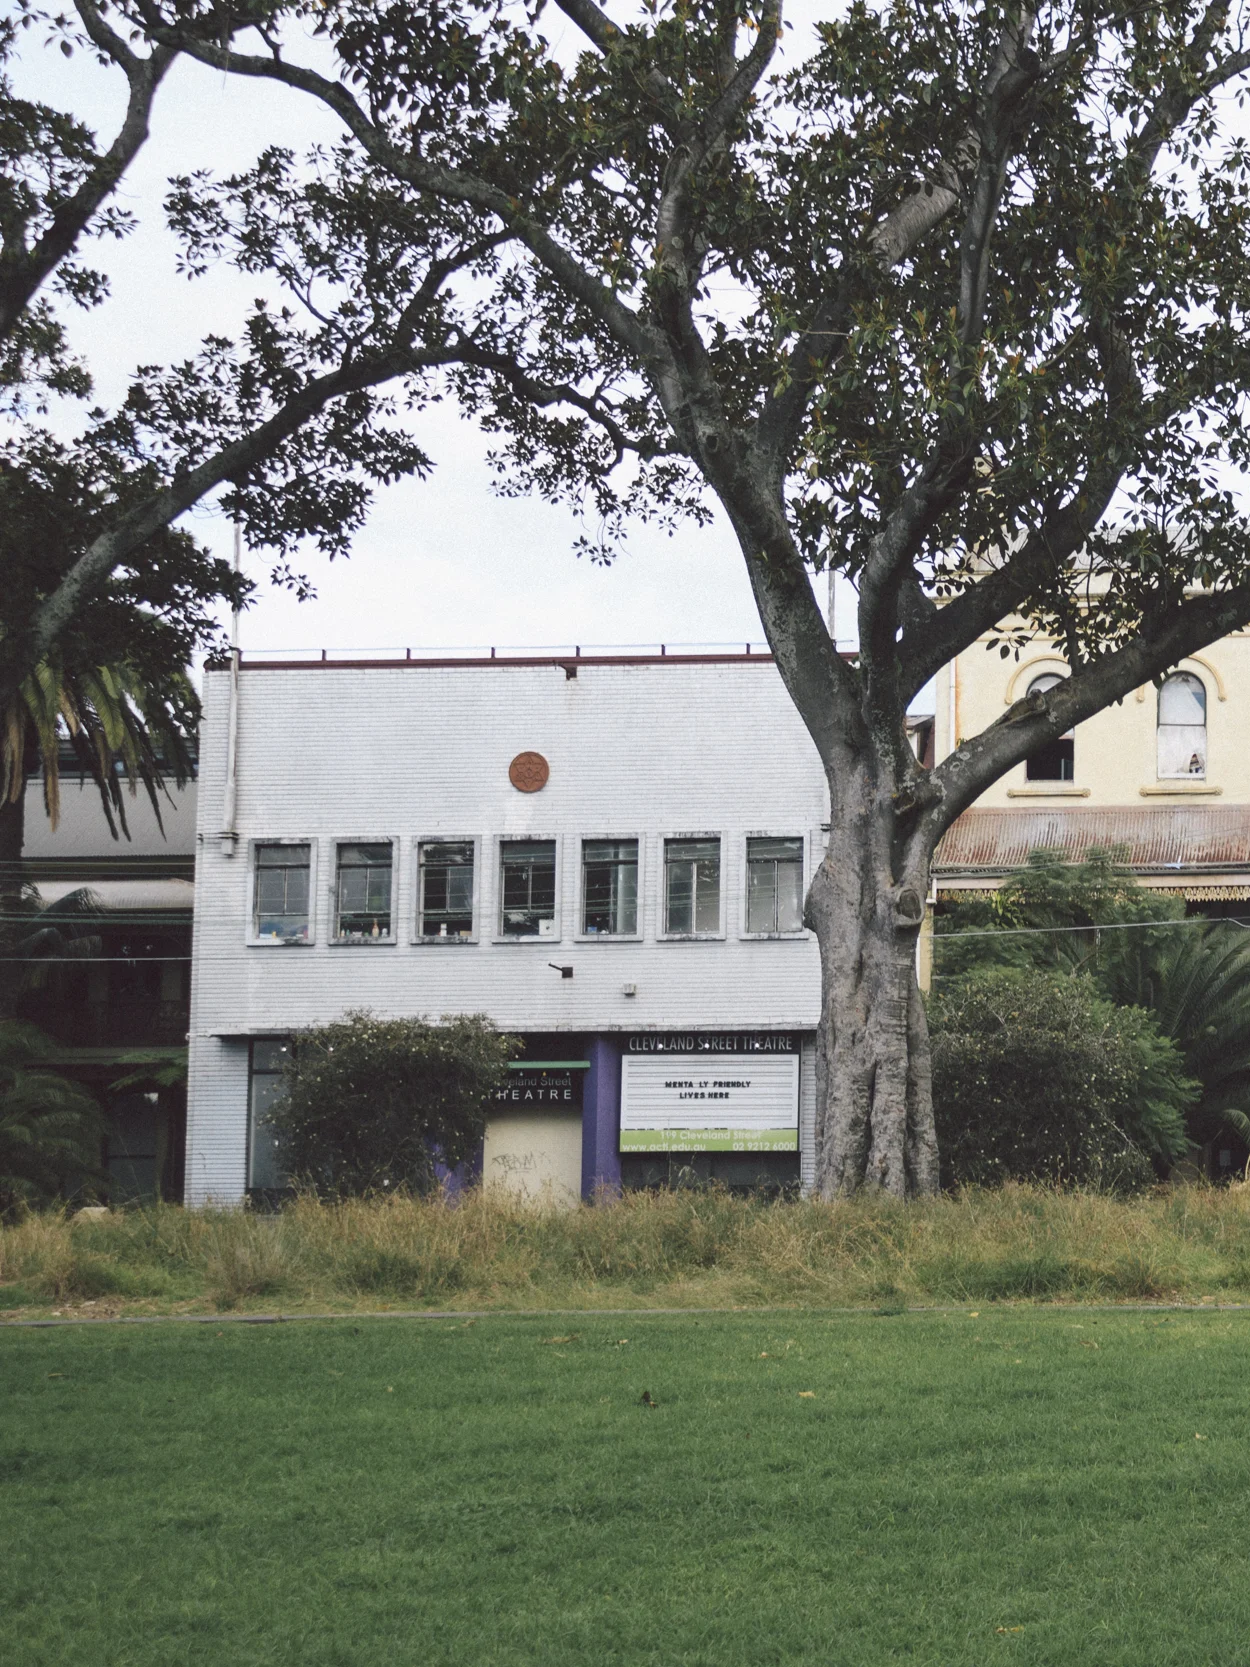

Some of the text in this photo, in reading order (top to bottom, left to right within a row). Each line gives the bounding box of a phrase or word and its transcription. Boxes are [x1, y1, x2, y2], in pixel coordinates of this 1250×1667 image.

[629, 1036, 694, 1050] CLEVELAND
[743, 1036, 792, 1050] THEATRE
[540, 1077, 572, 1086] Street
[679, 1130, 730, 1140] Cleveland
[732, 1142, 745, 1151] 02
